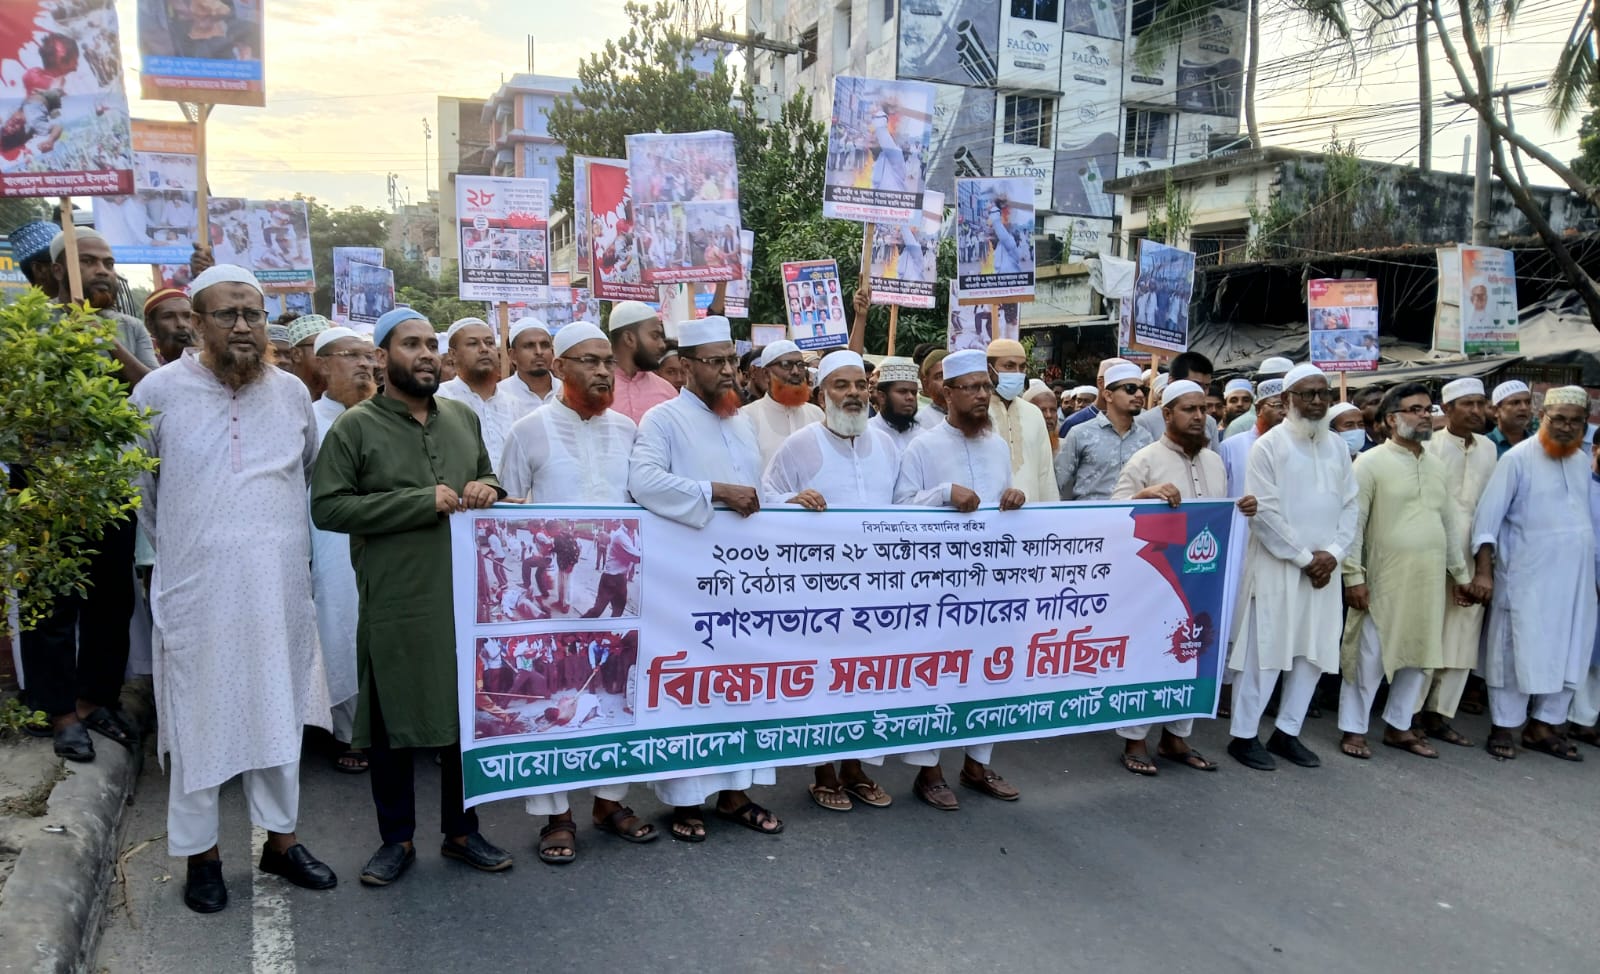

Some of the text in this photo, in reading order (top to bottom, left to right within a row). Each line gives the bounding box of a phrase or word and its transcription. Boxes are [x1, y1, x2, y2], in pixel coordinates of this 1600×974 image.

[1007, 38, 1050, 53] FALCON
[1072, 52, 1110, 66] FALCON
[1004, 167, 1047, 178] FALCON
[467, 189, 495, 207] ২৮
[862, 520, 986, 534] বিসমিল্লাহির রহমানির রহিম
[712, 533, 1105, 565] ২০০৬ সালের ২৮ অক্টোবর আওয়ামী ফ্যাসিবাদের
[697, 562, 1112, 597] লগি বৈঠার তান্ডবে সারা দেশব্যাপী অসংখ্য মানুষ কে
[691, 586, 1110, 650] নৃশংসভাবে হত্যার বিচারের দাবিতে
[1181, 623, 1204, 641] ২৮
[646, 625, 1130, 709] বিক্ষোভ সমাবেশ ও মিছিল
[628, 727, 748, 767] বাংলাদেশ
[753, 720, 867, 753] জামায়াতে
[872, 702, 958, 742] ইসলামী,
[965, 699, 1055, 731] বেনাপোল
[1059, 685, 1107, 720] পোর্ট
[1109, 688, 1149, 715] থানা
[1152, 683, 1195, 710] শাখা
